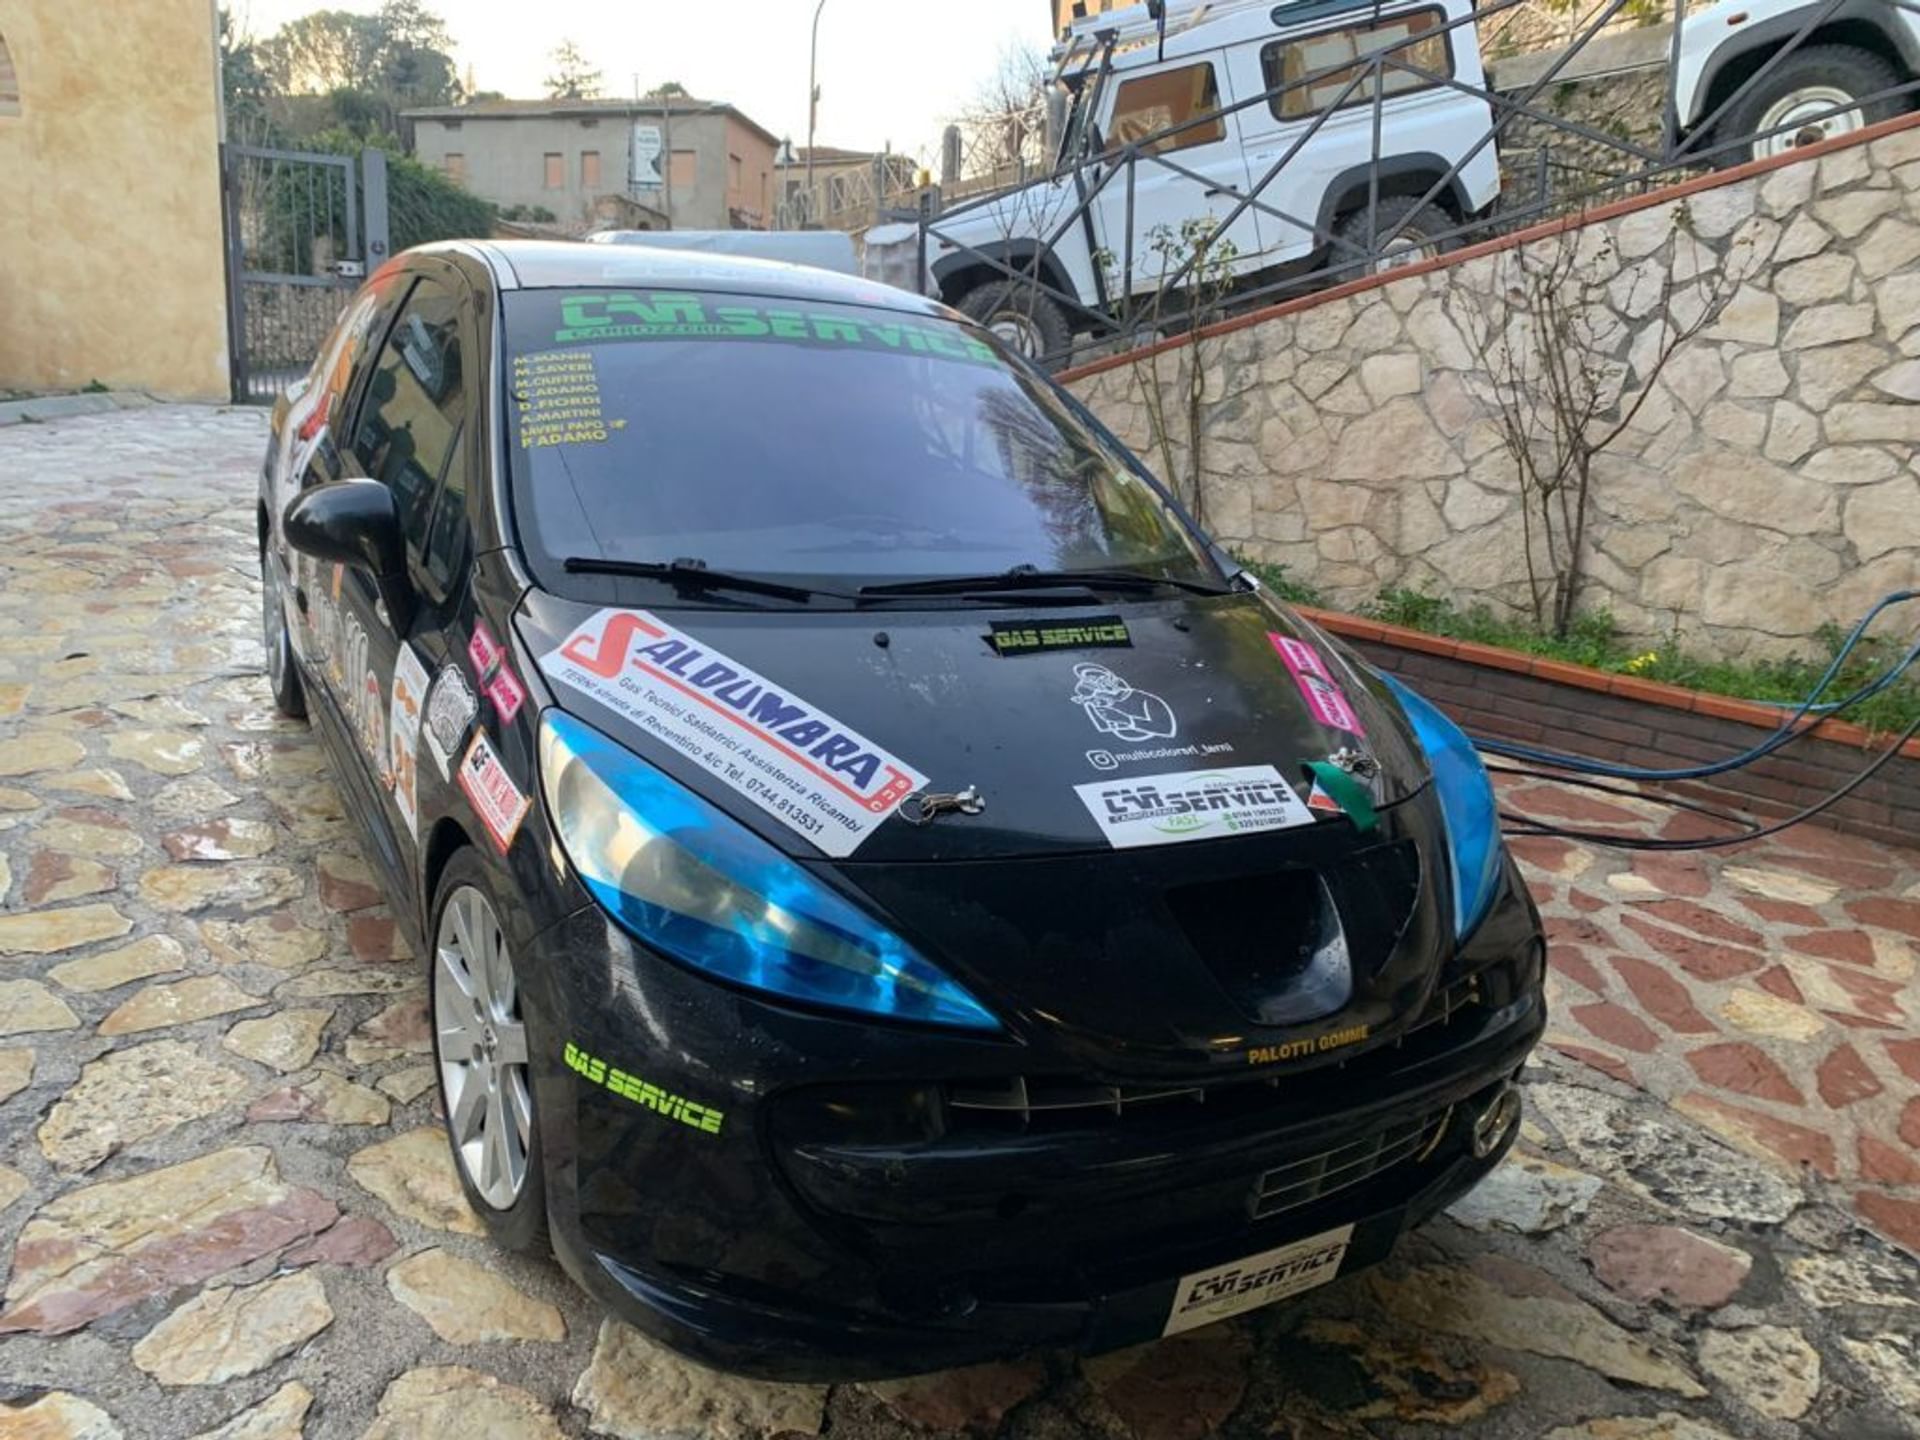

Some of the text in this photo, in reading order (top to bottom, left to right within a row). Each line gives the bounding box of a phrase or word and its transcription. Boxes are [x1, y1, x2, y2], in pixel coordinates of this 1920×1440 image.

[570, 322, 734, 341] CARROZZERIA
[717, 307, 1002, 369] SERVICE
[994, 624, 1128, 648] GAS SERVICE
[561, 668, 598, 689] TERNI
[643, 715, 703, 755] Recentino
[723, 762, 744, 785] Tel.
[745, 777, 826, 836] 0744.813531
[618, 676, 865, 834] Gas Tecnici Saldatrici Assistenza Ricambi
[1164, 782, 1292, 814] SERVICE
[1249, 1024, 1370, 1065] PALOTTI GOMME
[563, 1041, 725, 1135] GAS SERVICE
[1237, 1243, 1343, 1295] SERVICE
